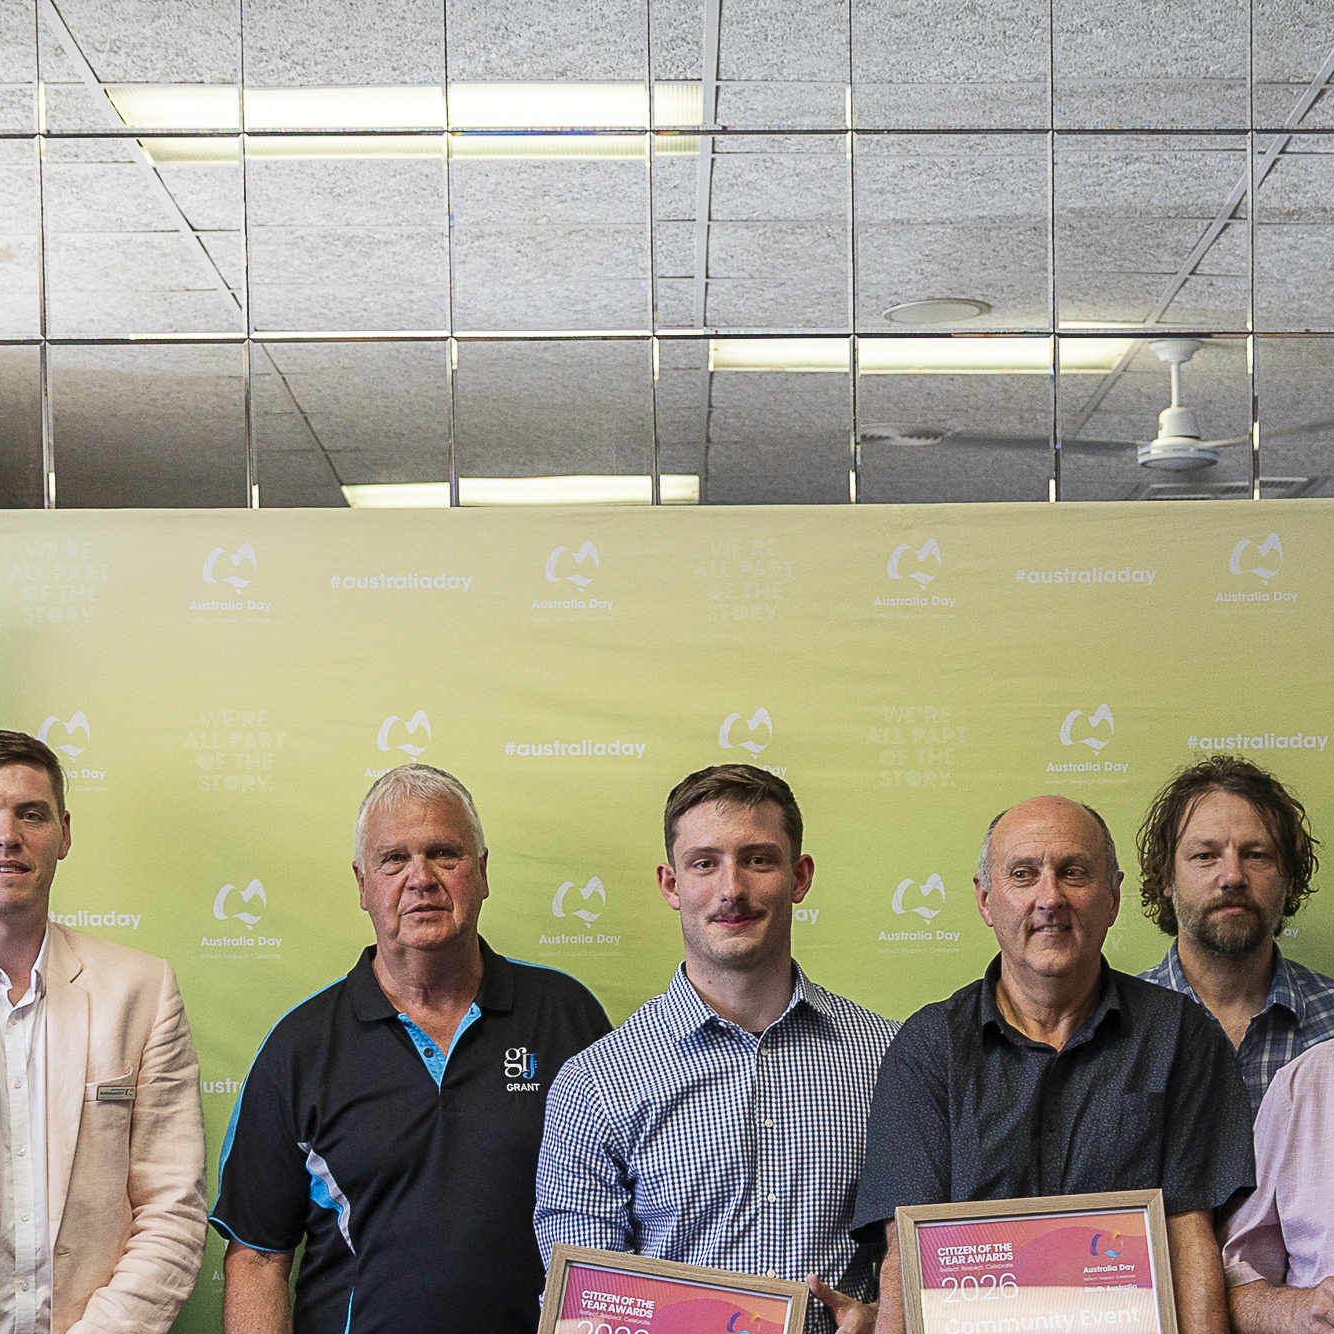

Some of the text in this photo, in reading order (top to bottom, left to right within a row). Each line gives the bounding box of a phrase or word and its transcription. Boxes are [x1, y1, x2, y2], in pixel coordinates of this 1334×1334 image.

[330, 572, 472, 593] #australiaday
[1014, 566, 1157, 587] #australiaday
[873, 595, 956, 610] Australia Day
[1214, 590, 1298, 604] Australia Day
[188, 600, 272, 614] Australia Day
[531, 598, 614, 613] Australia Day
[504, 739, 646, 760] #australiaday
[1187, 732, 1328, 752] #australiaday
[1046, 761, 1129, 776] Australia Day
[200, 936, 283, 950] Australia Day
[540, 933, 622, 948] Australia Day
[878, 929, 960, 944] Australia Day
[507, 1083, 540, 1091] GRANT
[937, 1243, 1013, 1257] CITIZEN OF THE
[938, 1252, 1014, 1266] YEAR AWARDS
[1083, 1263, 1135, 1274] Australia Day
[941, 1272, 1019, 1303] 2026
[1084, 1283, 1138, 1293] South Australia
[581, 1290, 655, 1310] CITIZEN OF THE
[581, 1299, 653, 1318] YEAR AWARDS
[1080, 1306, 1140, 1327] Event
